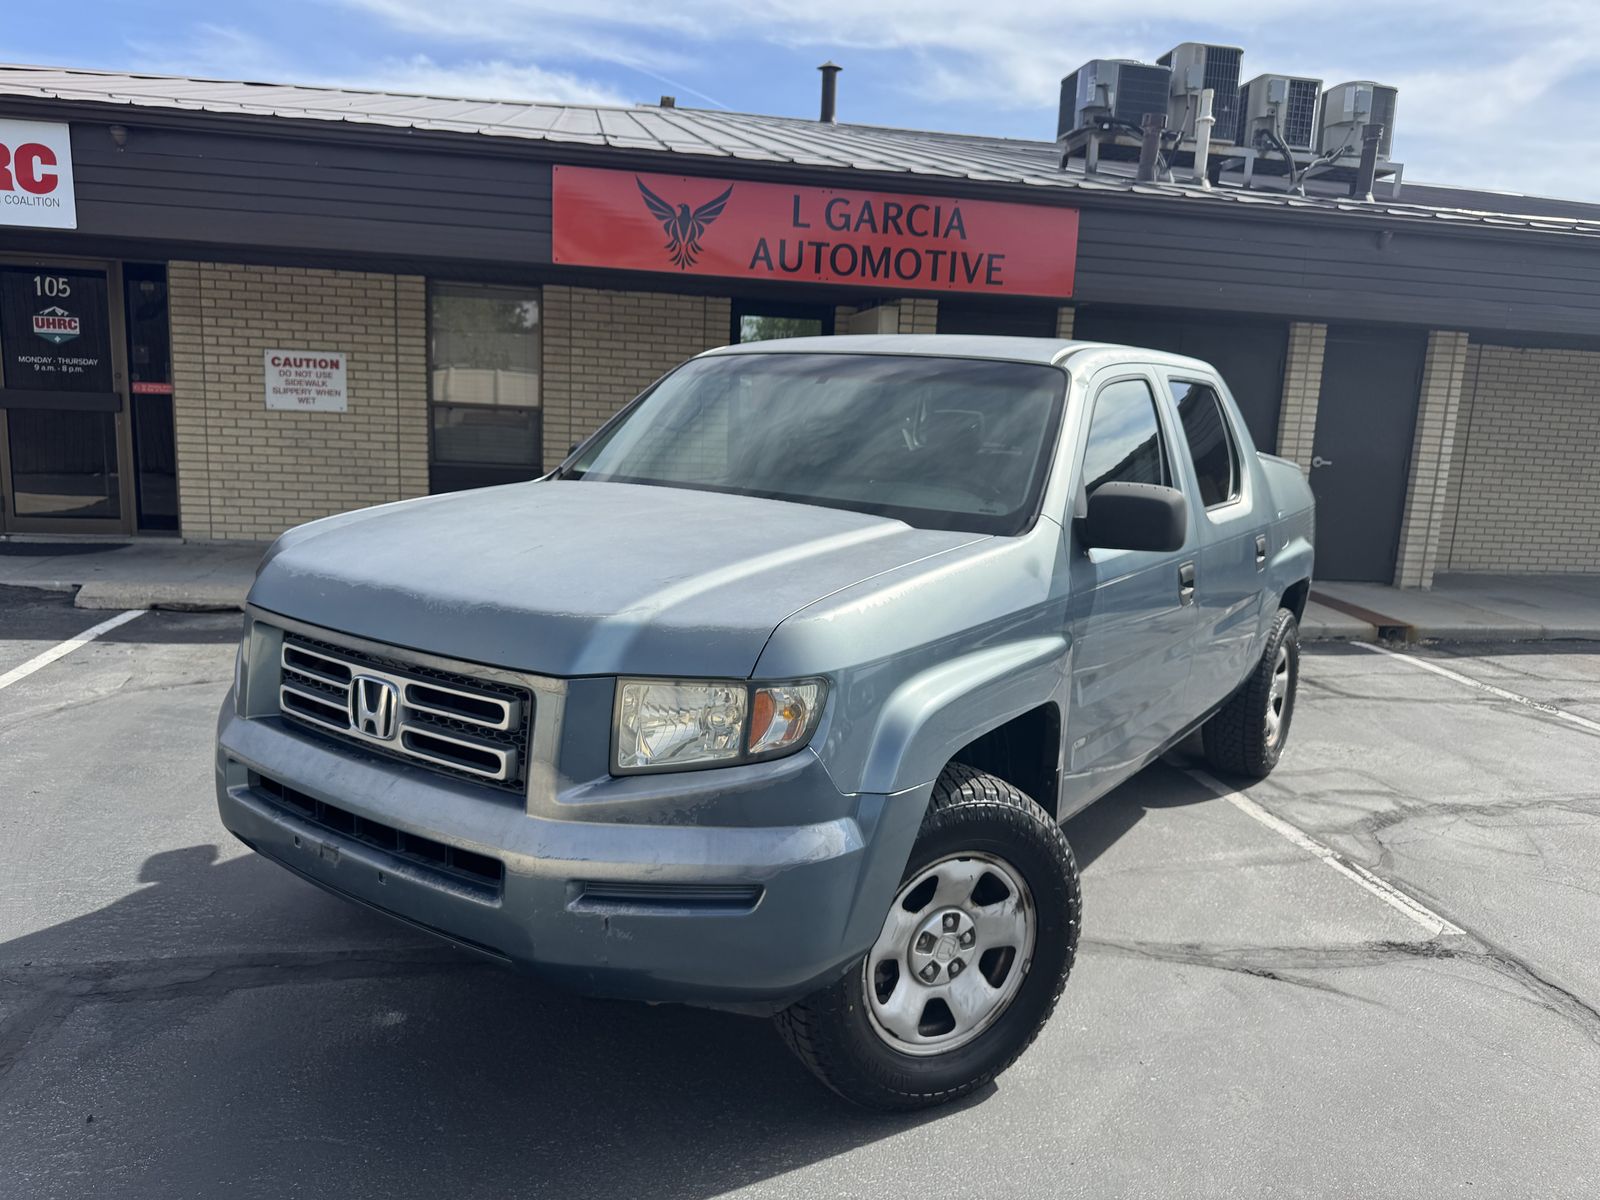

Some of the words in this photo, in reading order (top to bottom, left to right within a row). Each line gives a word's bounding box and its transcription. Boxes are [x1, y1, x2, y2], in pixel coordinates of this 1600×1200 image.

[4, 194, 60, 208] COALITION
[792, 193, 811, 229] L
[824, 198, 968, 240] GARCIA
[749, 237, 1006, 286] AUTOMOTIVE
[33, 275, 71, 297] 105
[34, 317, 78, 330] UHRC
[18, 355, 52, 363] MONDAY
[58, 357, 98, 366] THURSDAY
[271, 356, 340, 370] CAUTION
[279, 369, 292, 378] DO
[295, 370, 312, 378] NOT
[315, 371, 333, 379] USE
[284, 378, 328, 387] SIDEWALK
[272, 386, 313, 396] SLIPPERY
[315, 388, 342, 397] WHEN
[297, 396, 317, 405] WET
